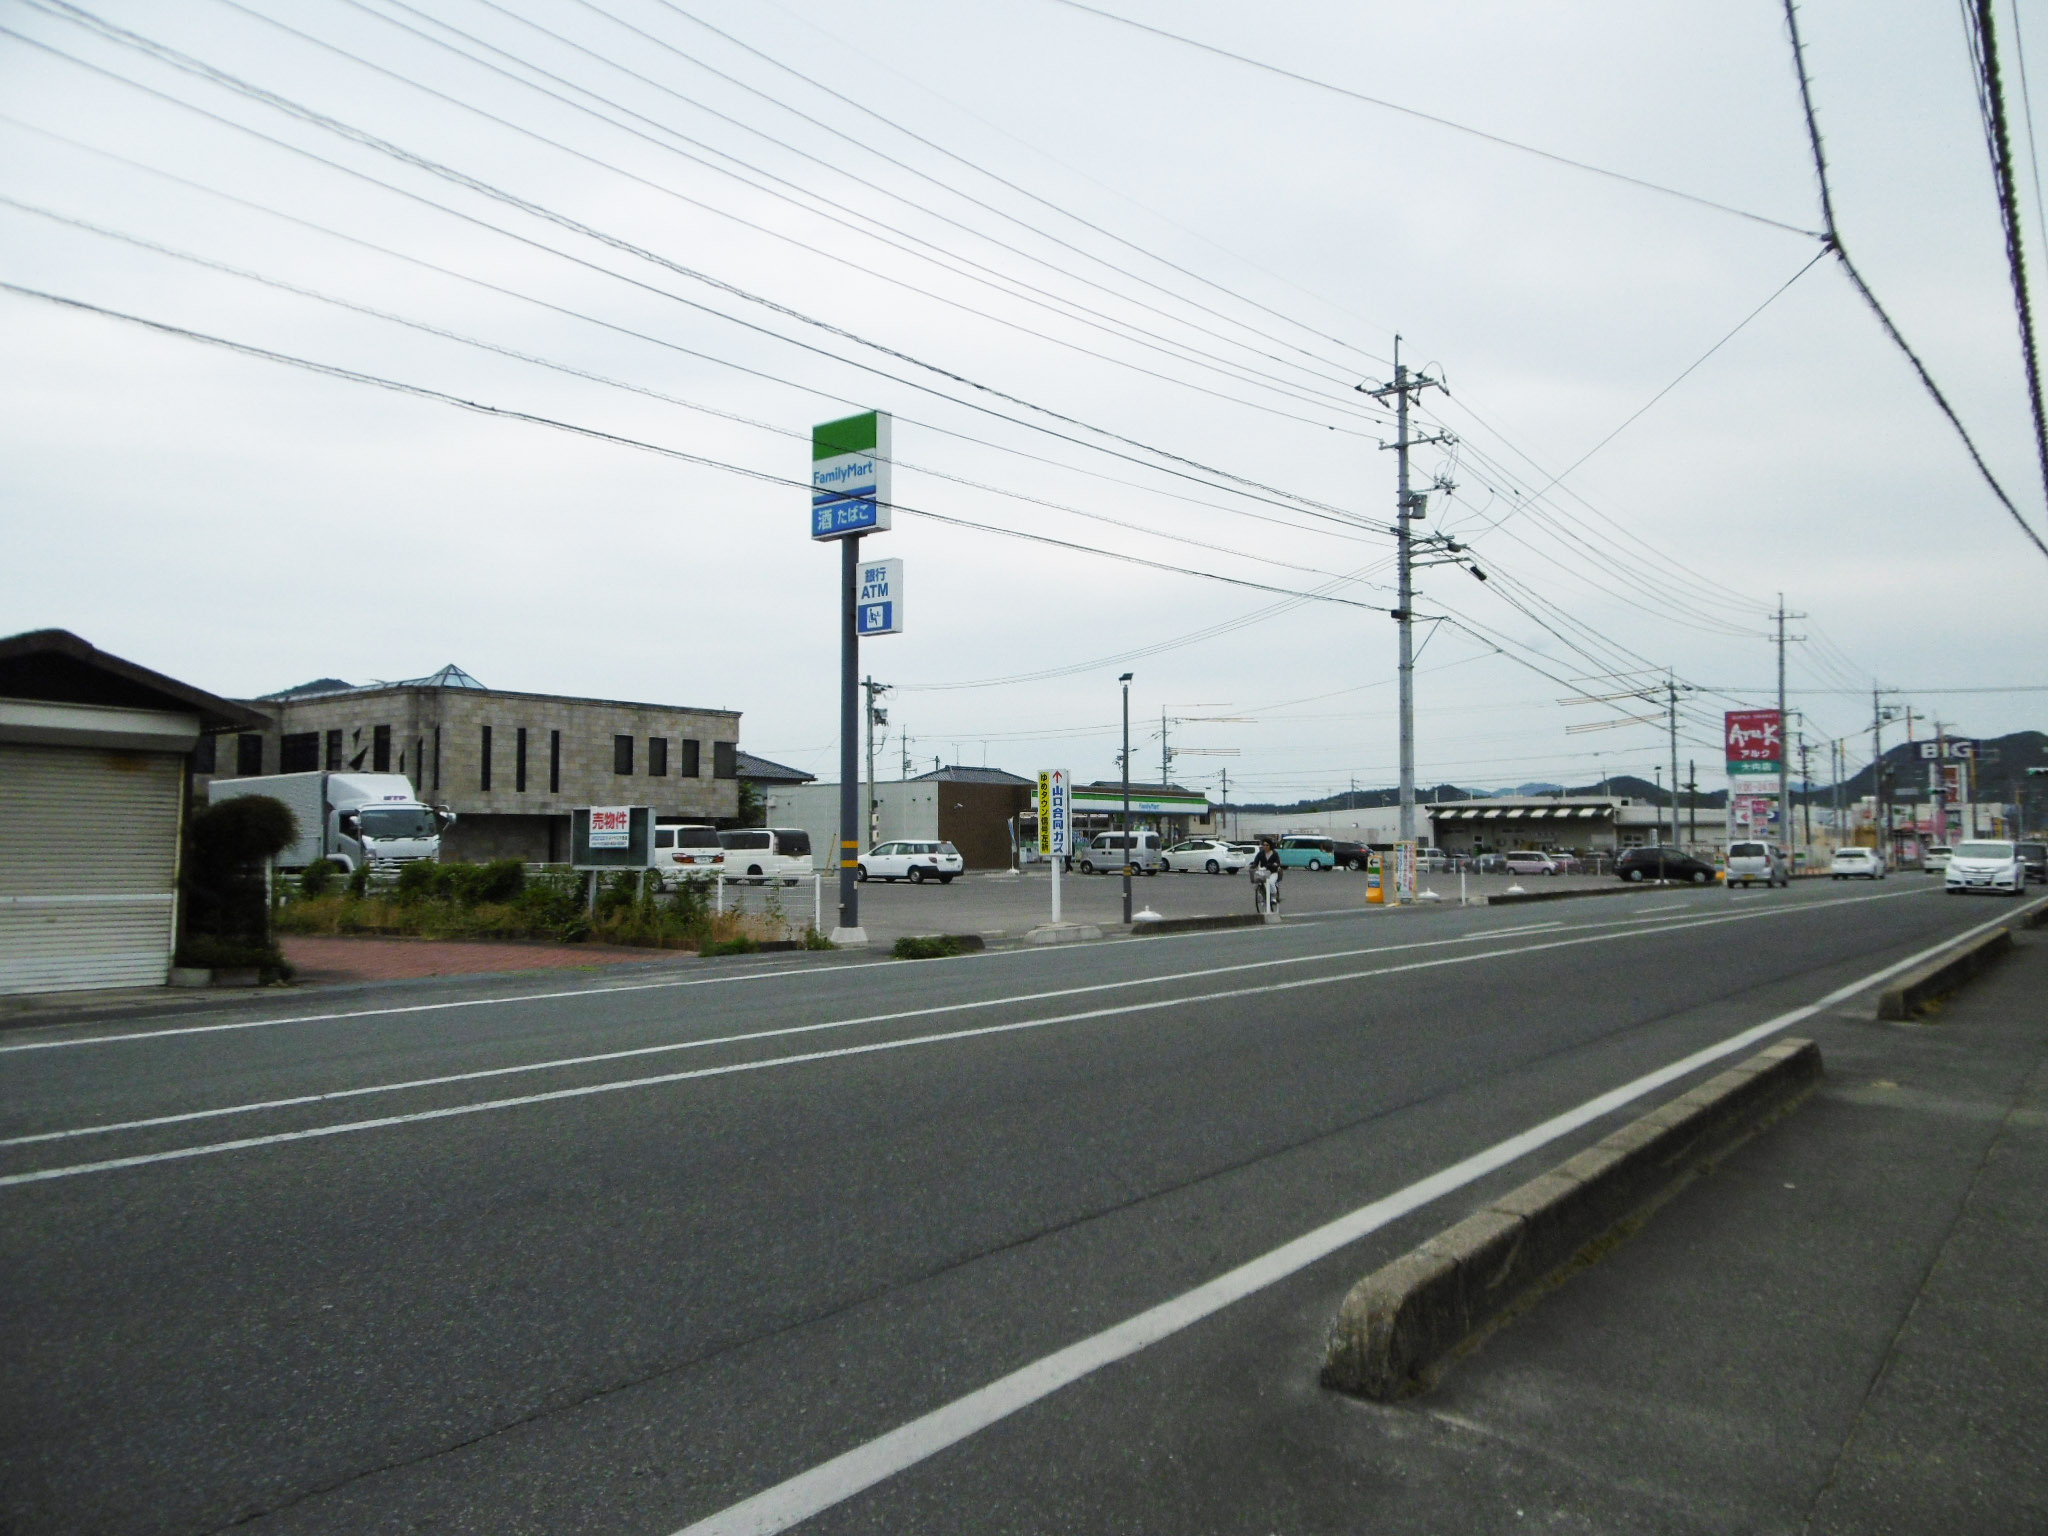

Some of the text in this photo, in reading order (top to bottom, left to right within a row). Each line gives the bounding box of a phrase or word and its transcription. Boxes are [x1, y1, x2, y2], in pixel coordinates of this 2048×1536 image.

[813, 460, 873, 486] FamilyMart
[817, 504, 869, 531] 酒 たばこ
[864, 566, 887, 584] 銀行
[861, 582, 889, 600] ATM
[1920, 742, 1972, 758] BIG
[592, 810, 627, 830] 売物件
[1040, 773, 1049, 852] ゆめタウン信号左折
[1052, 785, 1064, 854] 山口合同ガス
